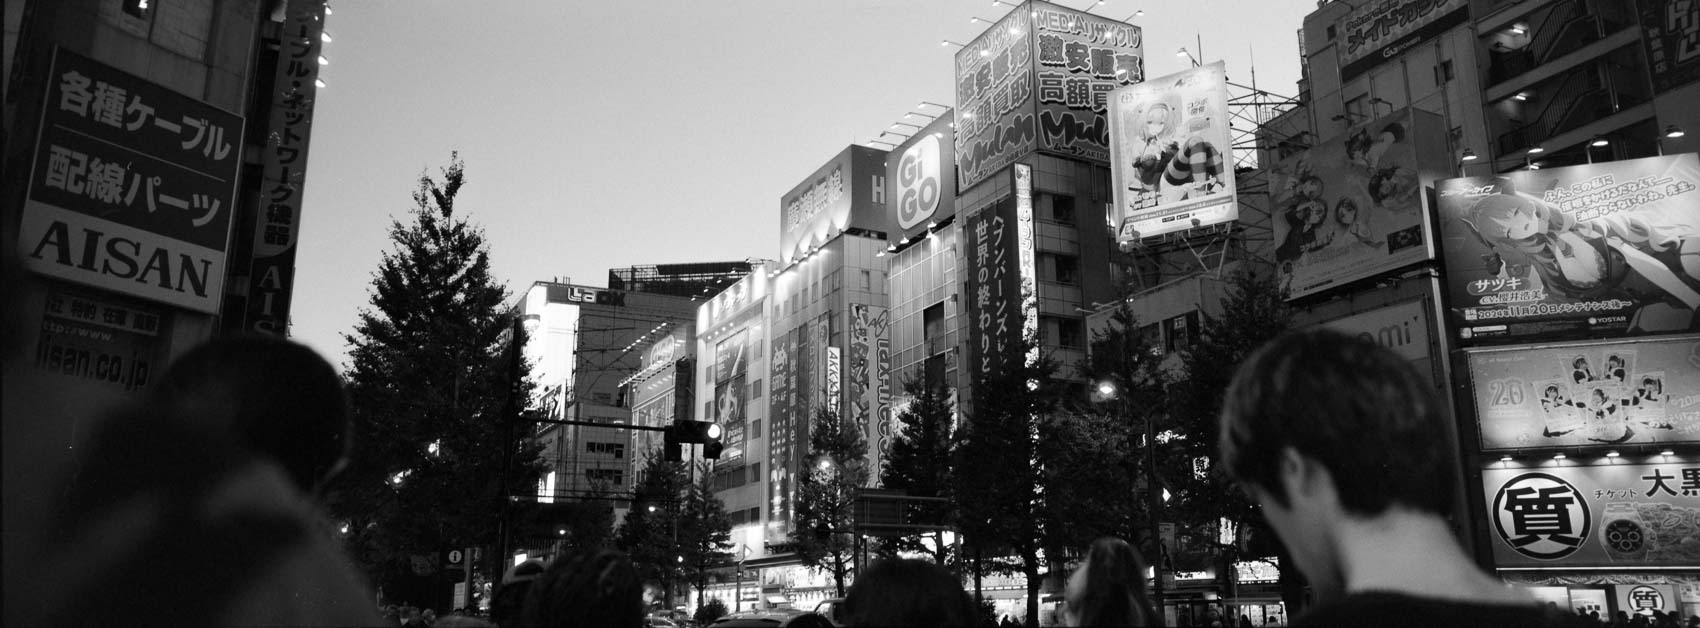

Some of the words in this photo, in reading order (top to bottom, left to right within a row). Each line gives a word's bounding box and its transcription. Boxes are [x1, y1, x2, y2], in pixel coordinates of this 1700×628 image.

[1036, 8, 1140, 48] MEDIAリサイクル
[959, 32, 1029, 110] 激安販売
[1038, 33, 1142, 84] 激安販売
[60, 70, 231, 162] 各種ケーブル
[264, 13, 314, 246] ーブル・ネットワーク機器
[959, 69, 1030, 147] 高額買取
[1038, 109, 1109, 149] Mul
[959, 113, 1035, 187] Mulan
[45, 144, 221, 228] 配線パーツ
[29, 221, 213, 299] AISAN
[1475, 276, 1522, 293] サツキ
[1597, 315, 1627, 325] YOSTAR
[36, 343, 149, 393] isan.co.jp
[1489, 379, 1525, 407] 20
[1504, 485, 1583, 550] 質
[1594, 488, 1637, 500] チケット
